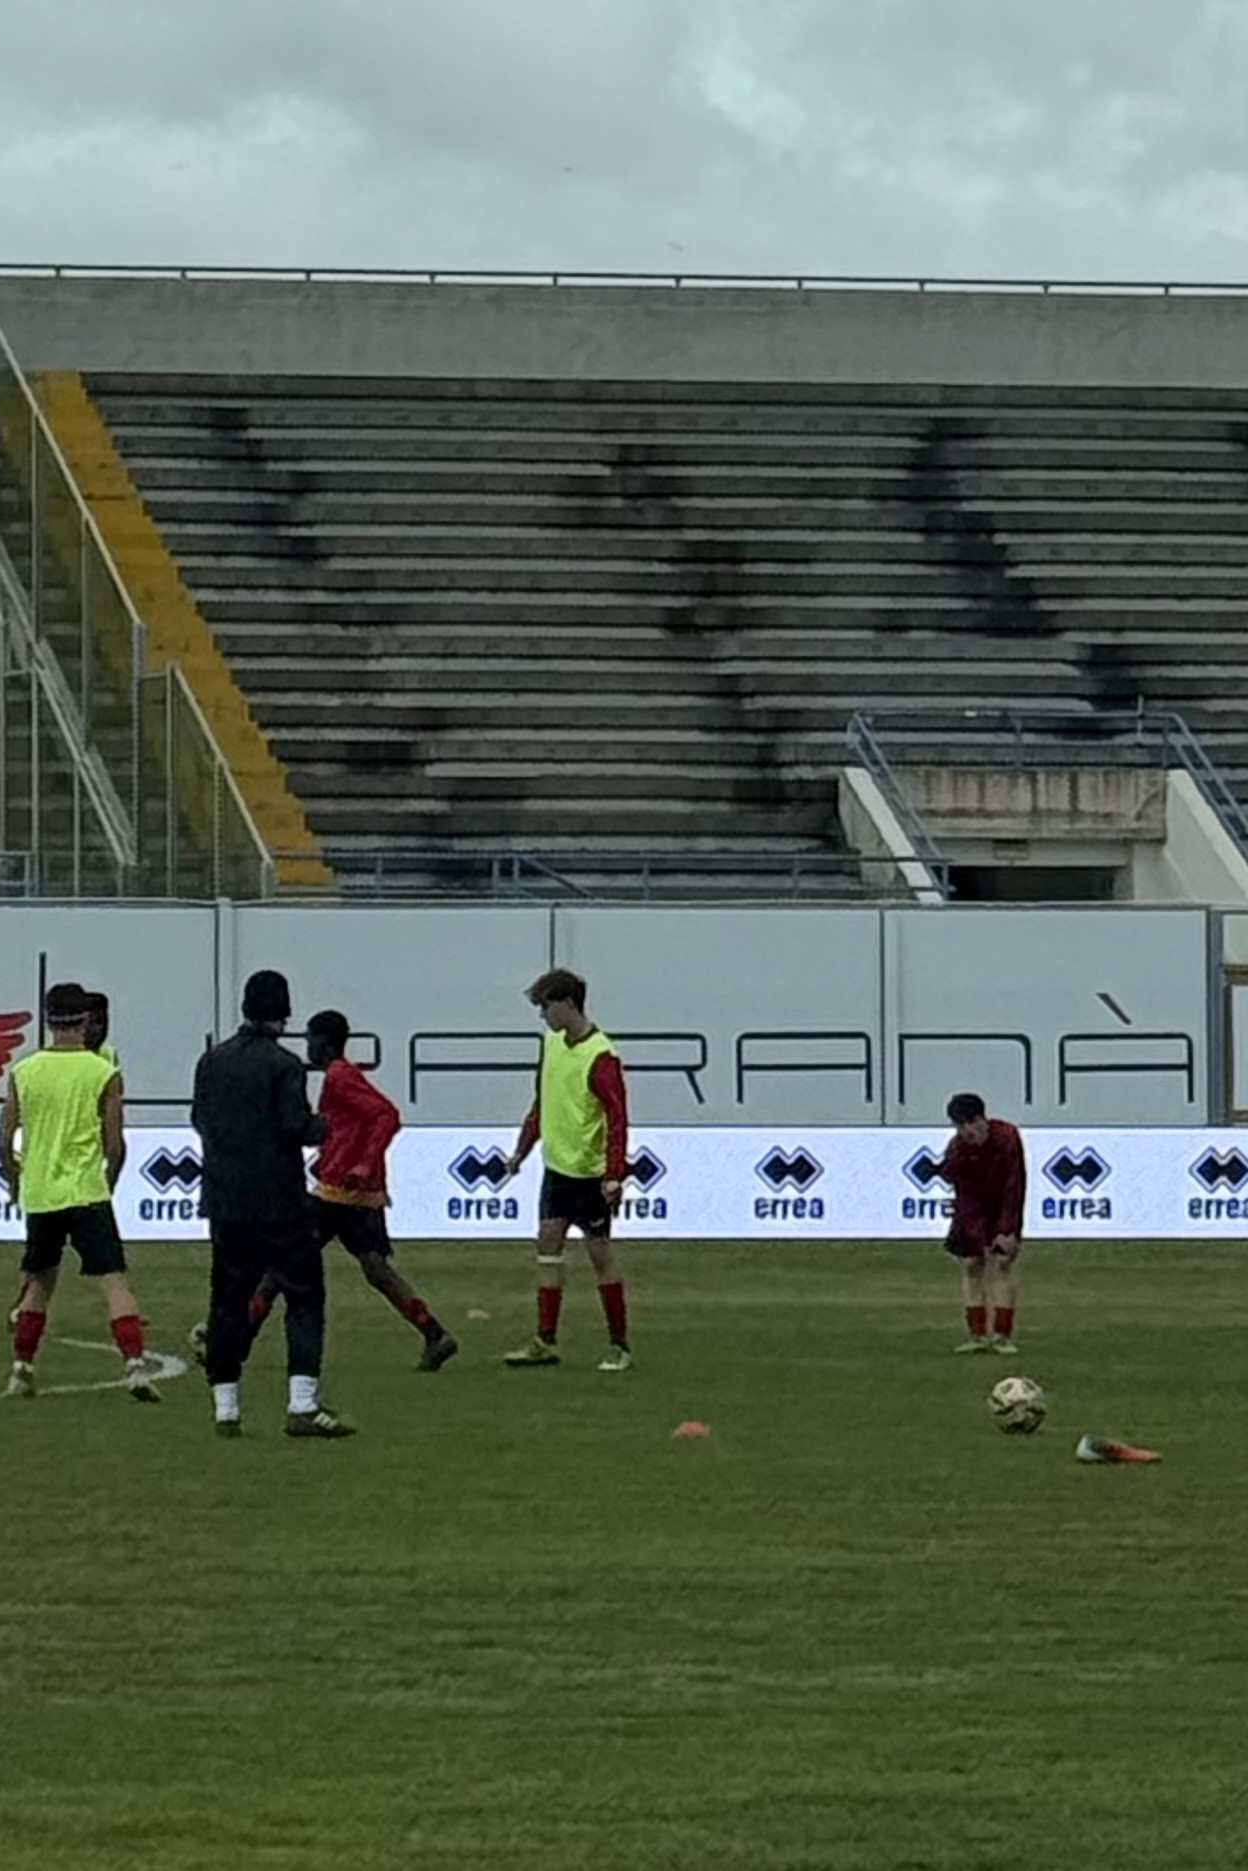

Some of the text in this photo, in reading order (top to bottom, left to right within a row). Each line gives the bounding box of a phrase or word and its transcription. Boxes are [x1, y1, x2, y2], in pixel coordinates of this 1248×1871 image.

[447, 1197, 518, 1220] errea
[754, 1197, 825, 1219] errea
[902, 1197, 956, 1219] erre
[1041, 1196, 1112, 1220] errea
